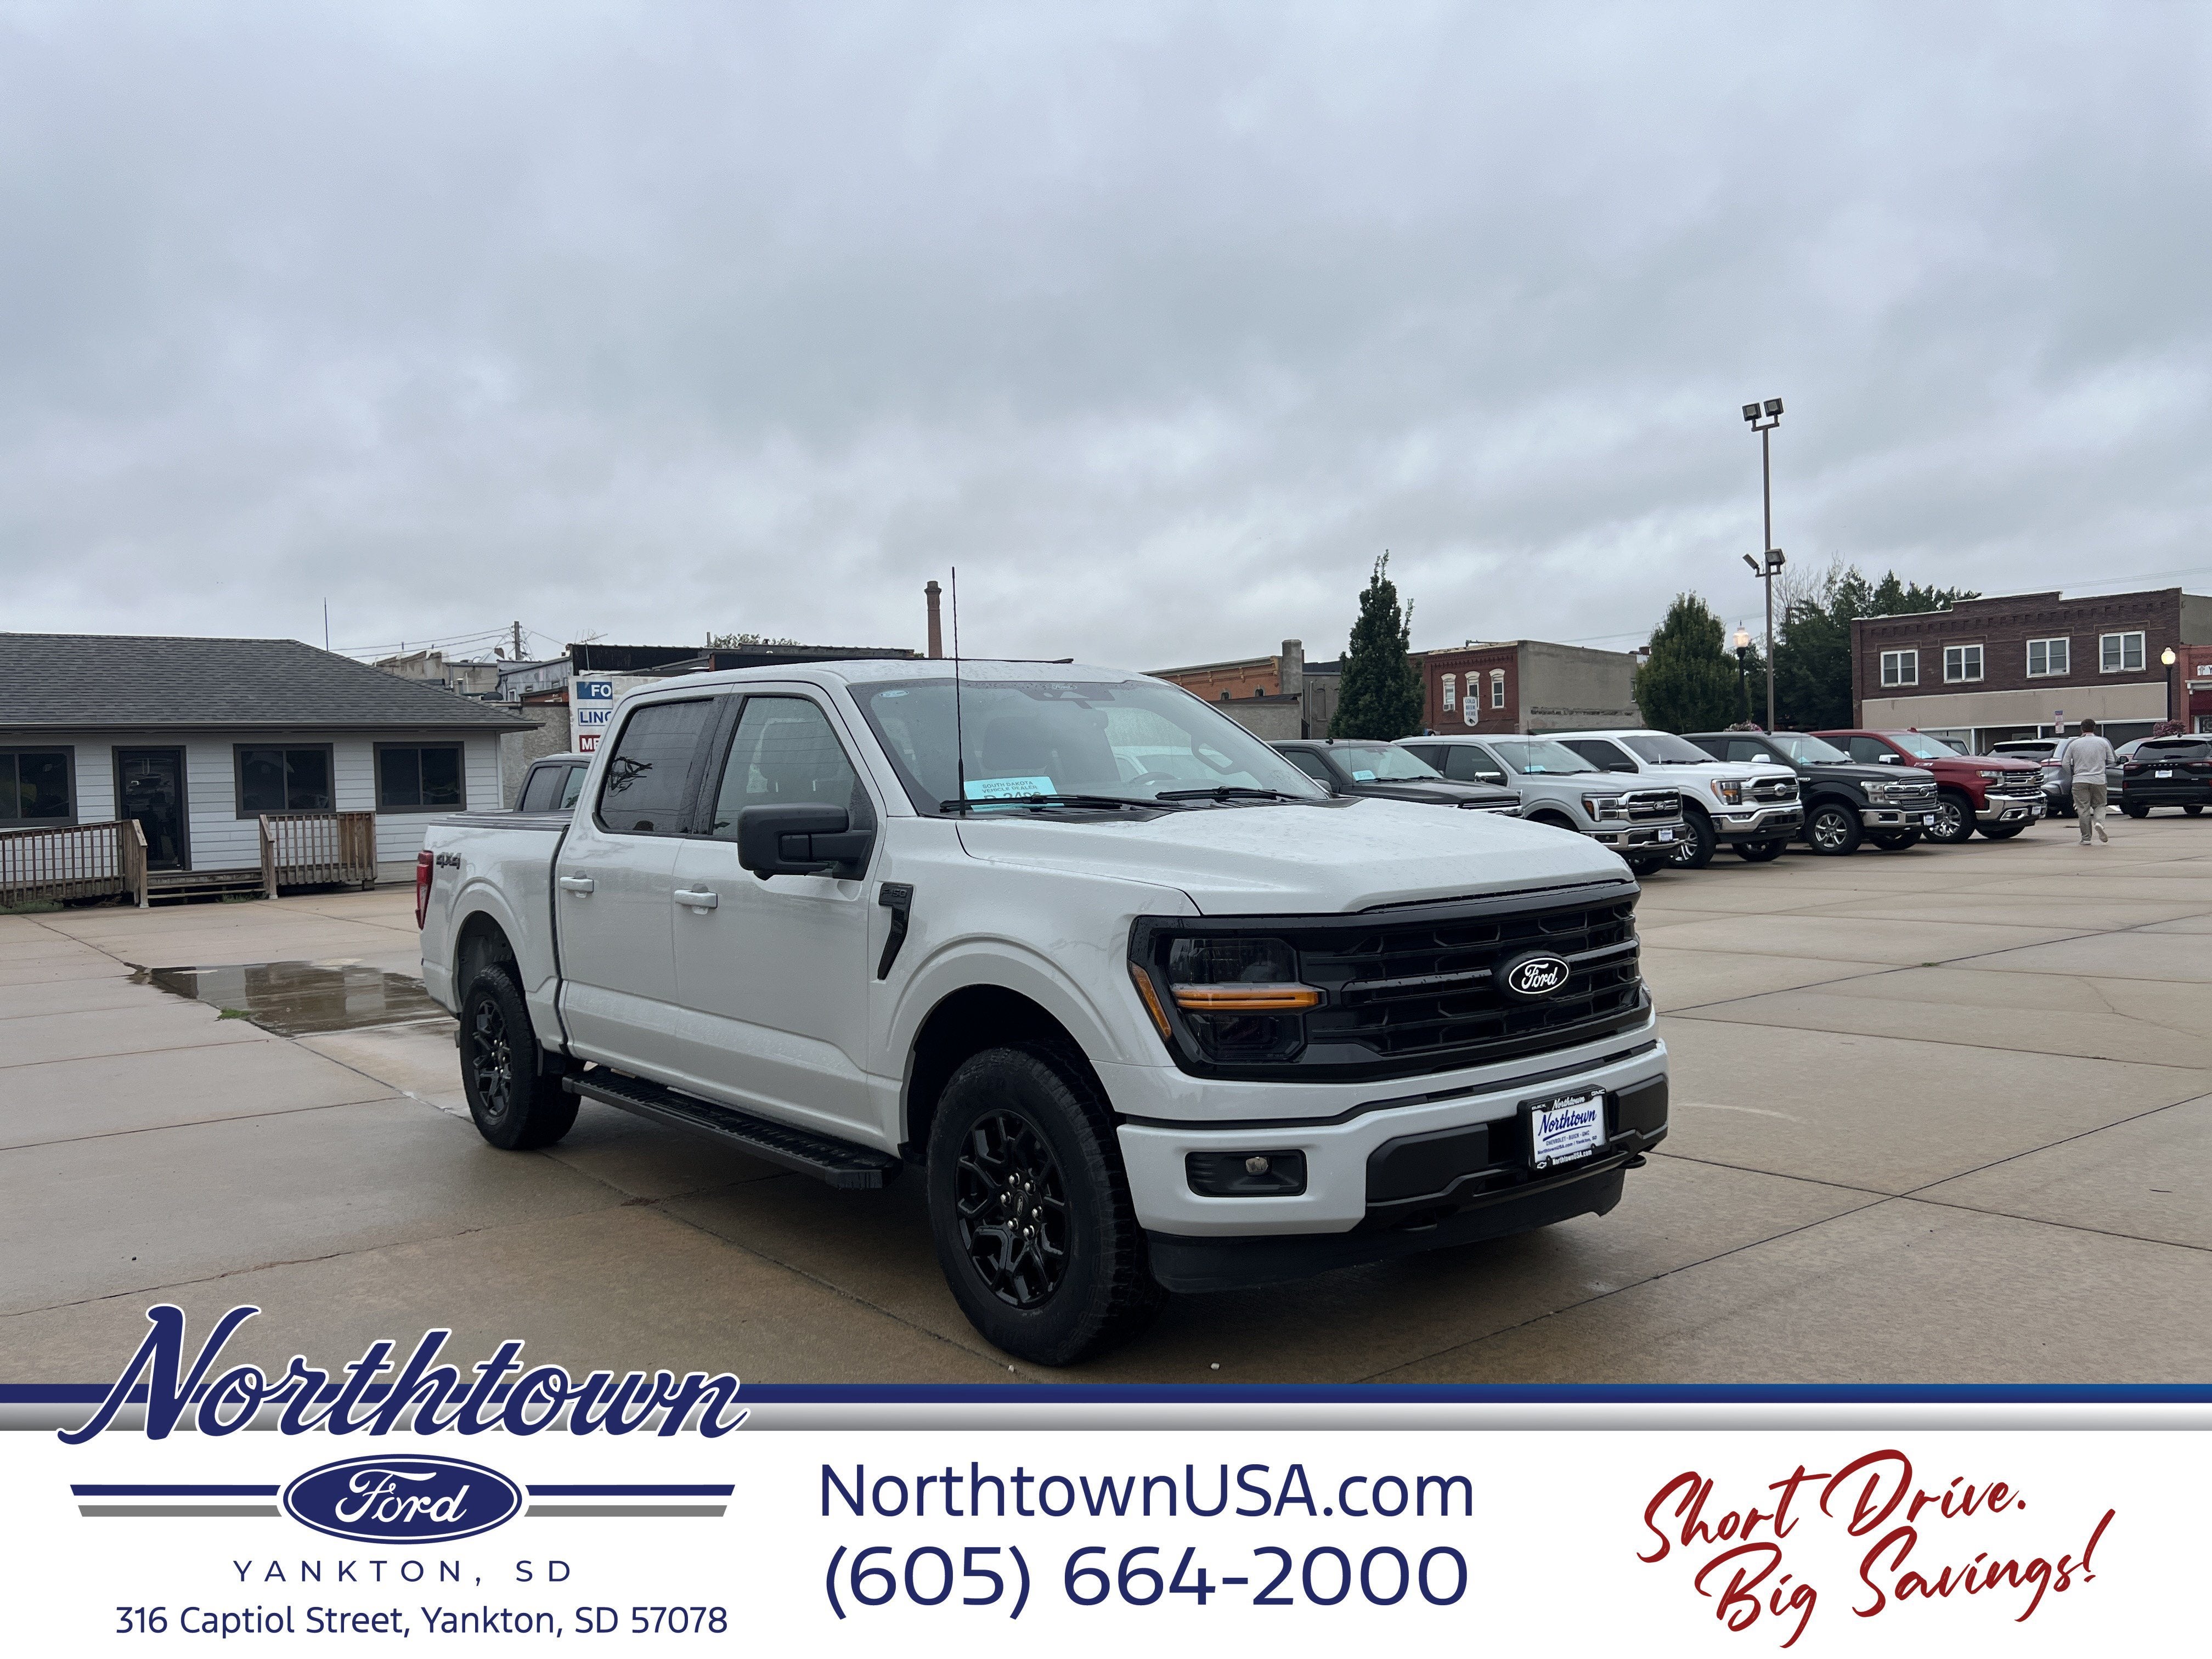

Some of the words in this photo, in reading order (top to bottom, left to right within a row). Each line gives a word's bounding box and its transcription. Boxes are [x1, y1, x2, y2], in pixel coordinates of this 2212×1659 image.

[591, 684, 612, 697] FO
[1521, 963, 1558, 989] Ford
[1551, 1096, 1585, 1111] Northtown
[1538, 1109, 1597, 1136] Northtown
[1546, 1136, 1566, 1146] CHEVROLET
[1552, 1150, 1593, 1165] NorthtownUSA.com
